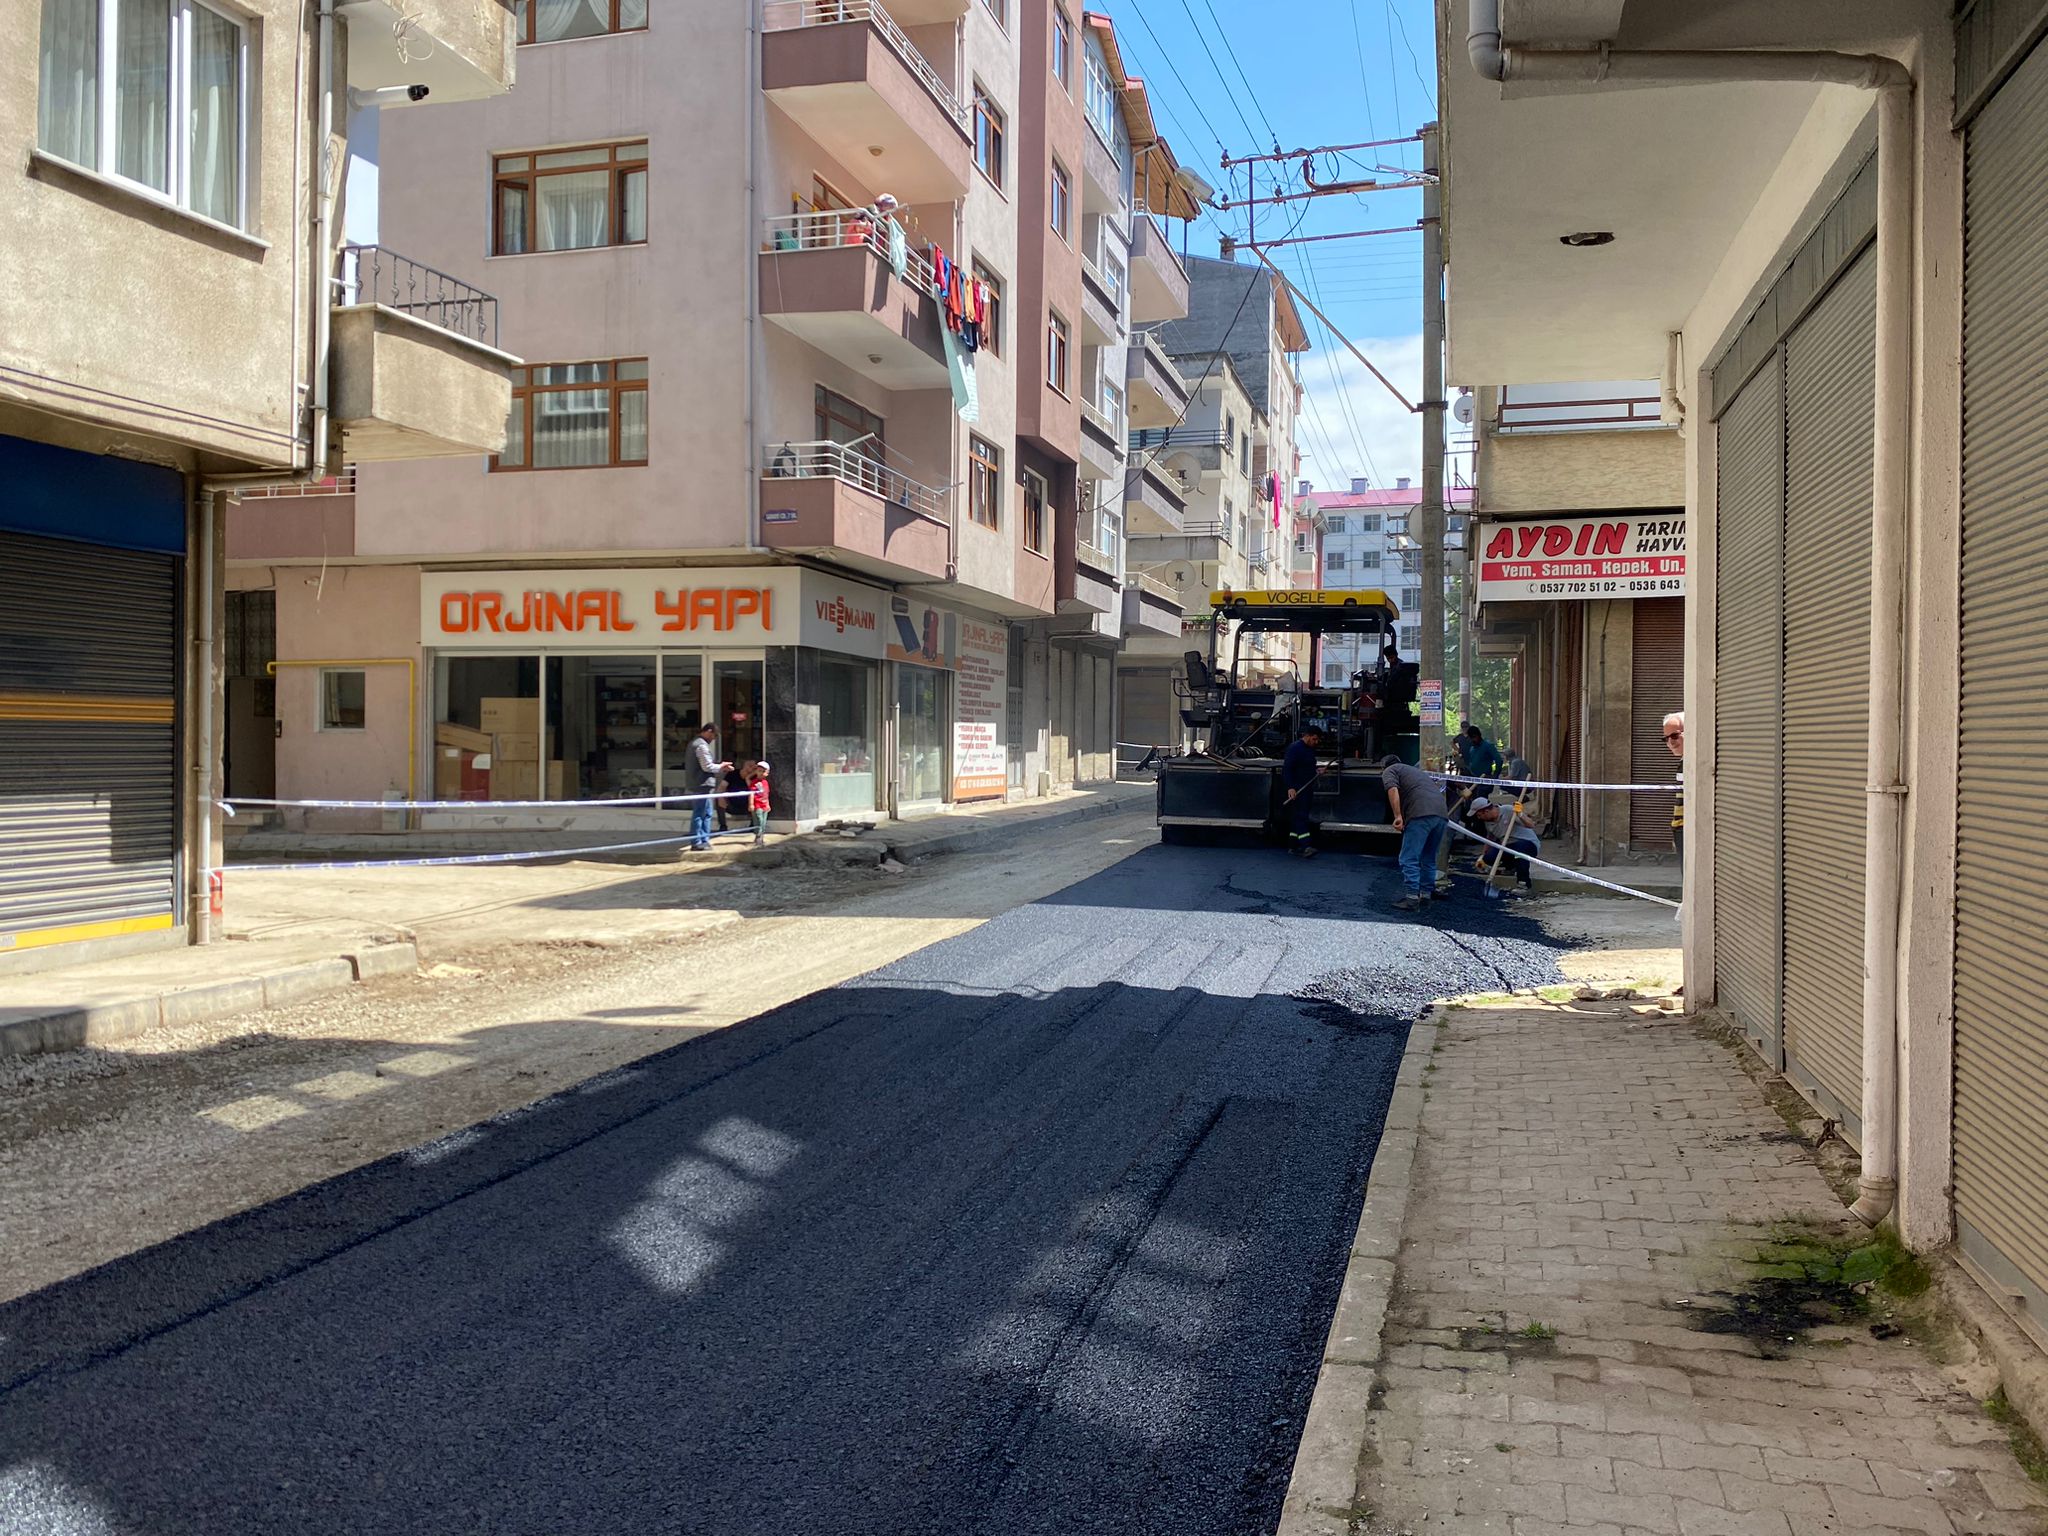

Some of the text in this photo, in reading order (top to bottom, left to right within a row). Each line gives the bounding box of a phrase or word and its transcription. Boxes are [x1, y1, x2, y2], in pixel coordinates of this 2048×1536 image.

[1486, 523, 1629, 559] AYDIN
[1636, 538, 1685, 553] HAYV
[1540, 583, 1565, 593] 0537
[1568, 583, 1586, 592] 702
[1589, 583, 1600, 592] 51
[1604, 582, 1616, 592] 02
[1629, 581, 1656, 590] 0536
[1660, 580, 1680, 589] 643
